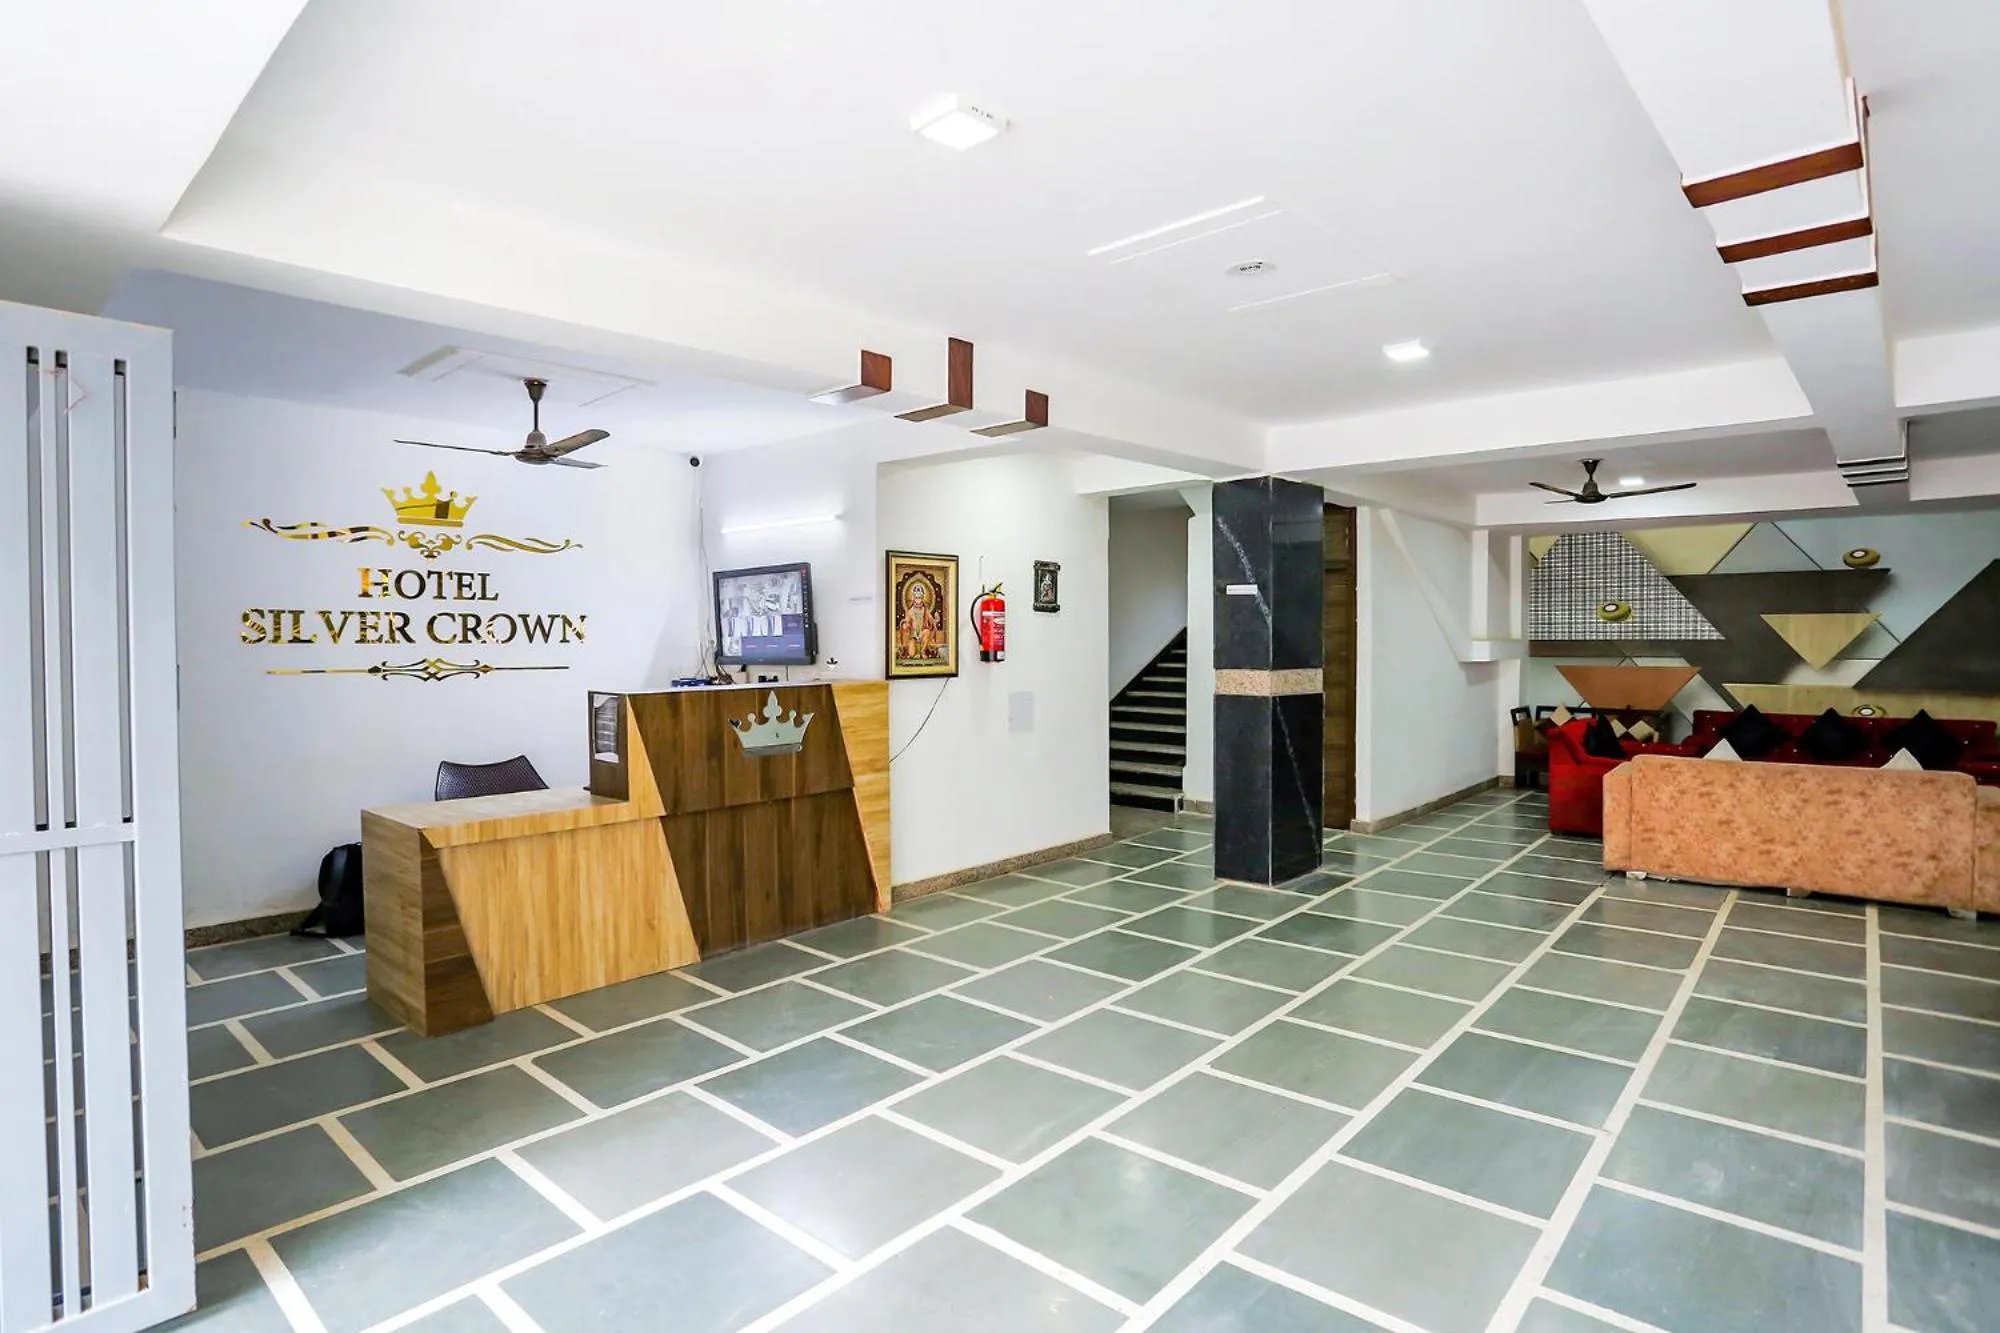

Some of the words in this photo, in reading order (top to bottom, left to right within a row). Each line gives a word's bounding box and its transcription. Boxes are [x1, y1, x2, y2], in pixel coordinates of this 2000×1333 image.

[357, 567, 499, 601] HOTEL
[240, 607, 416, 645] SILVER
[426, 611, 587, 645] CROWN
